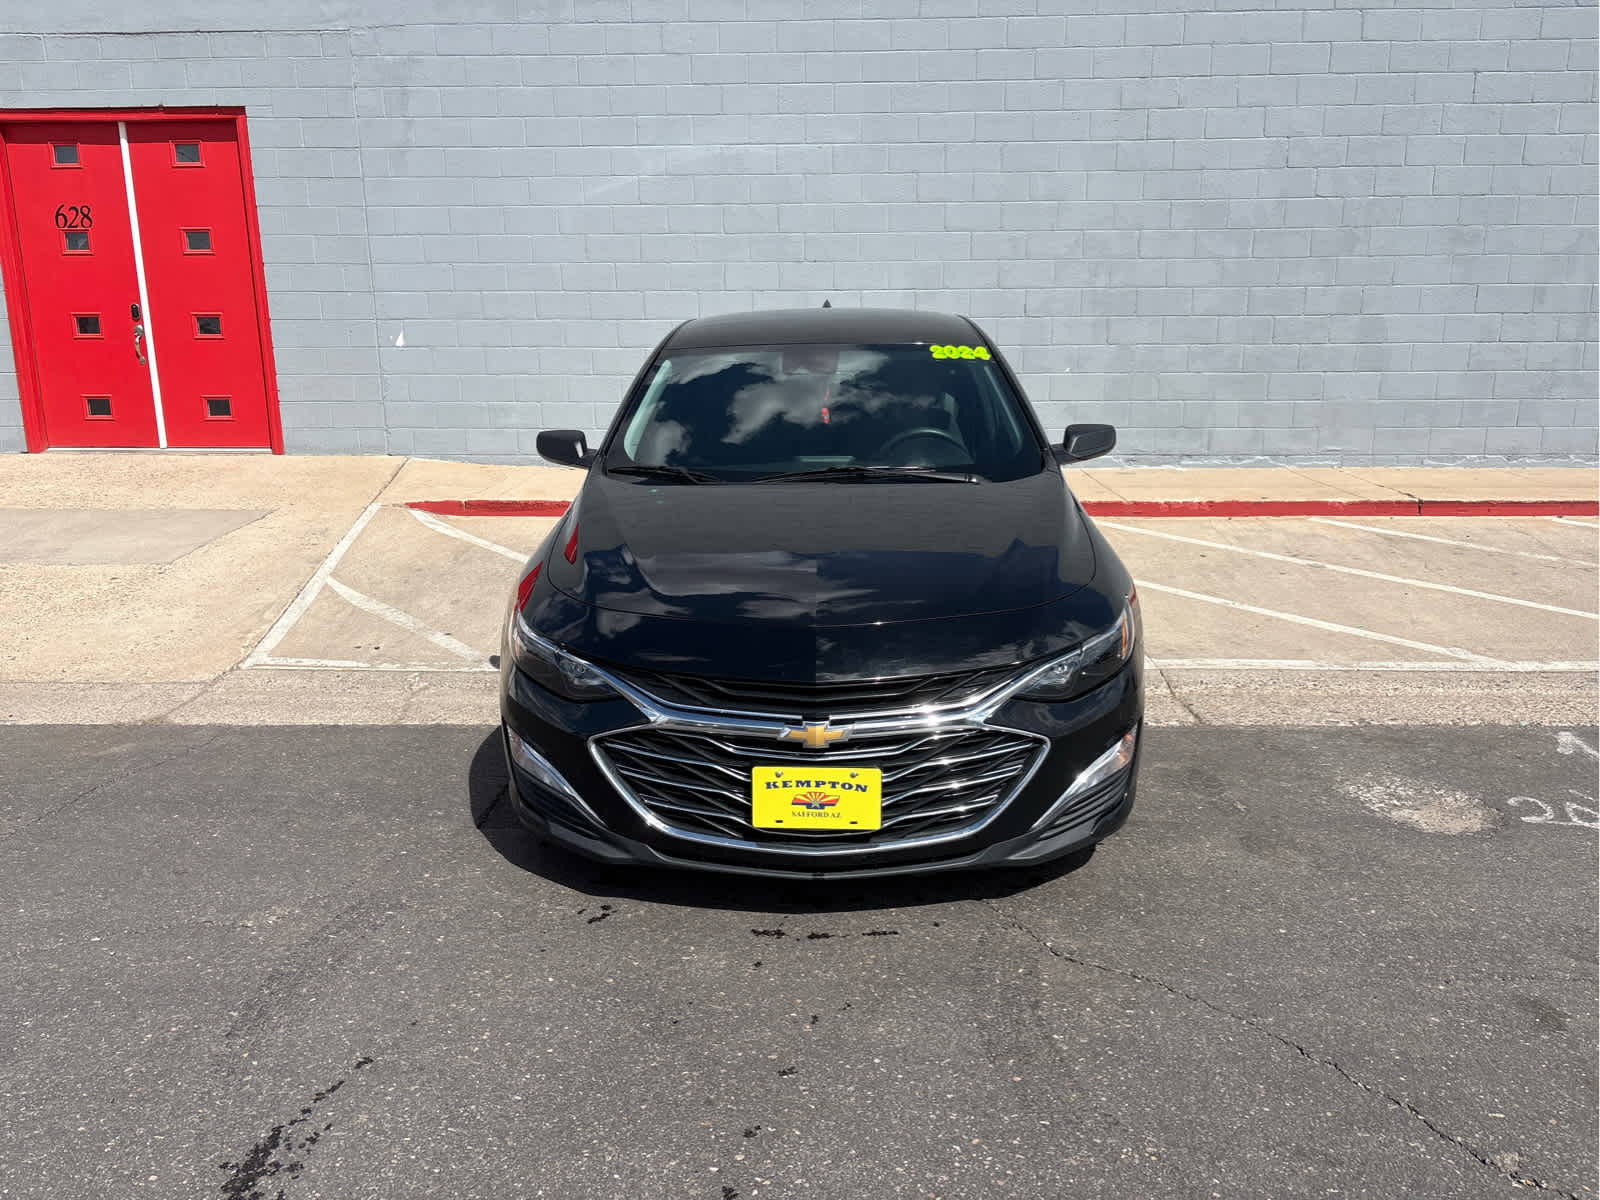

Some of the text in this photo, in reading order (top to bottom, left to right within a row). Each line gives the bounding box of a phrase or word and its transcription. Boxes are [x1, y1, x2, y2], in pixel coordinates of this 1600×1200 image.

[55, 204, 93, 228] 628
[929, 345, 991, 360] 2024
[765, 780, 868, 792] KEMPTON
